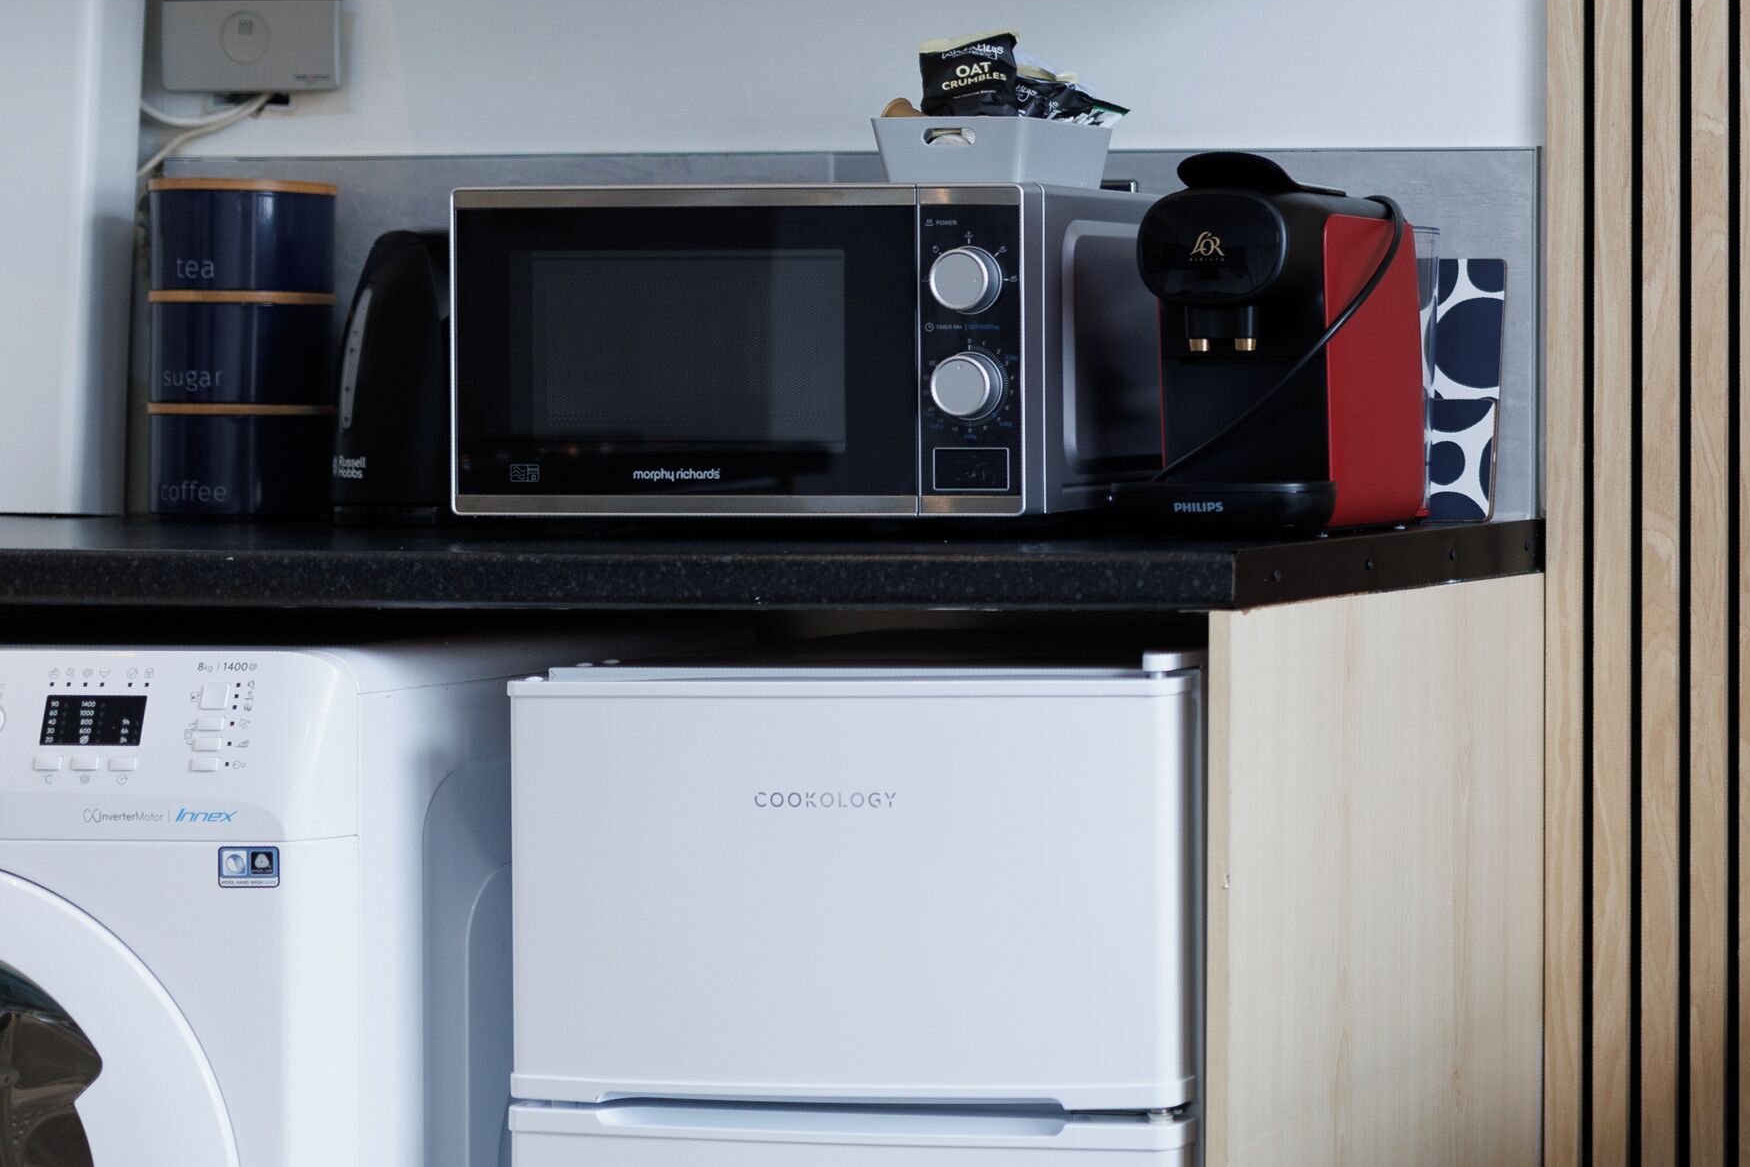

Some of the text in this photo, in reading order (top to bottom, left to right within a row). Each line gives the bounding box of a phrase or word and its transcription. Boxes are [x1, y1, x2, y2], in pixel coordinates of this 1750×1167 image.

[955, 61, 991, 78] OAT
[941, 71, 1007, 90] CRUMBLES
[176, 258, 215, 279] tea
[163, 369, 225, 392] sugar
[339, 455, 366, 468] Russell
[339, 466, 363, 479] Hobbs
[633, 468, 720, 482] morphy richards
[160, 481, 228, 503] coffee
[1174, 502, 1224, 513] PHILIPS
[197, 662, 248, 673] 8kg 1400
[754, 792, 896, 808] COOKOLOGY
[175, 808, 238, 823] Innex
